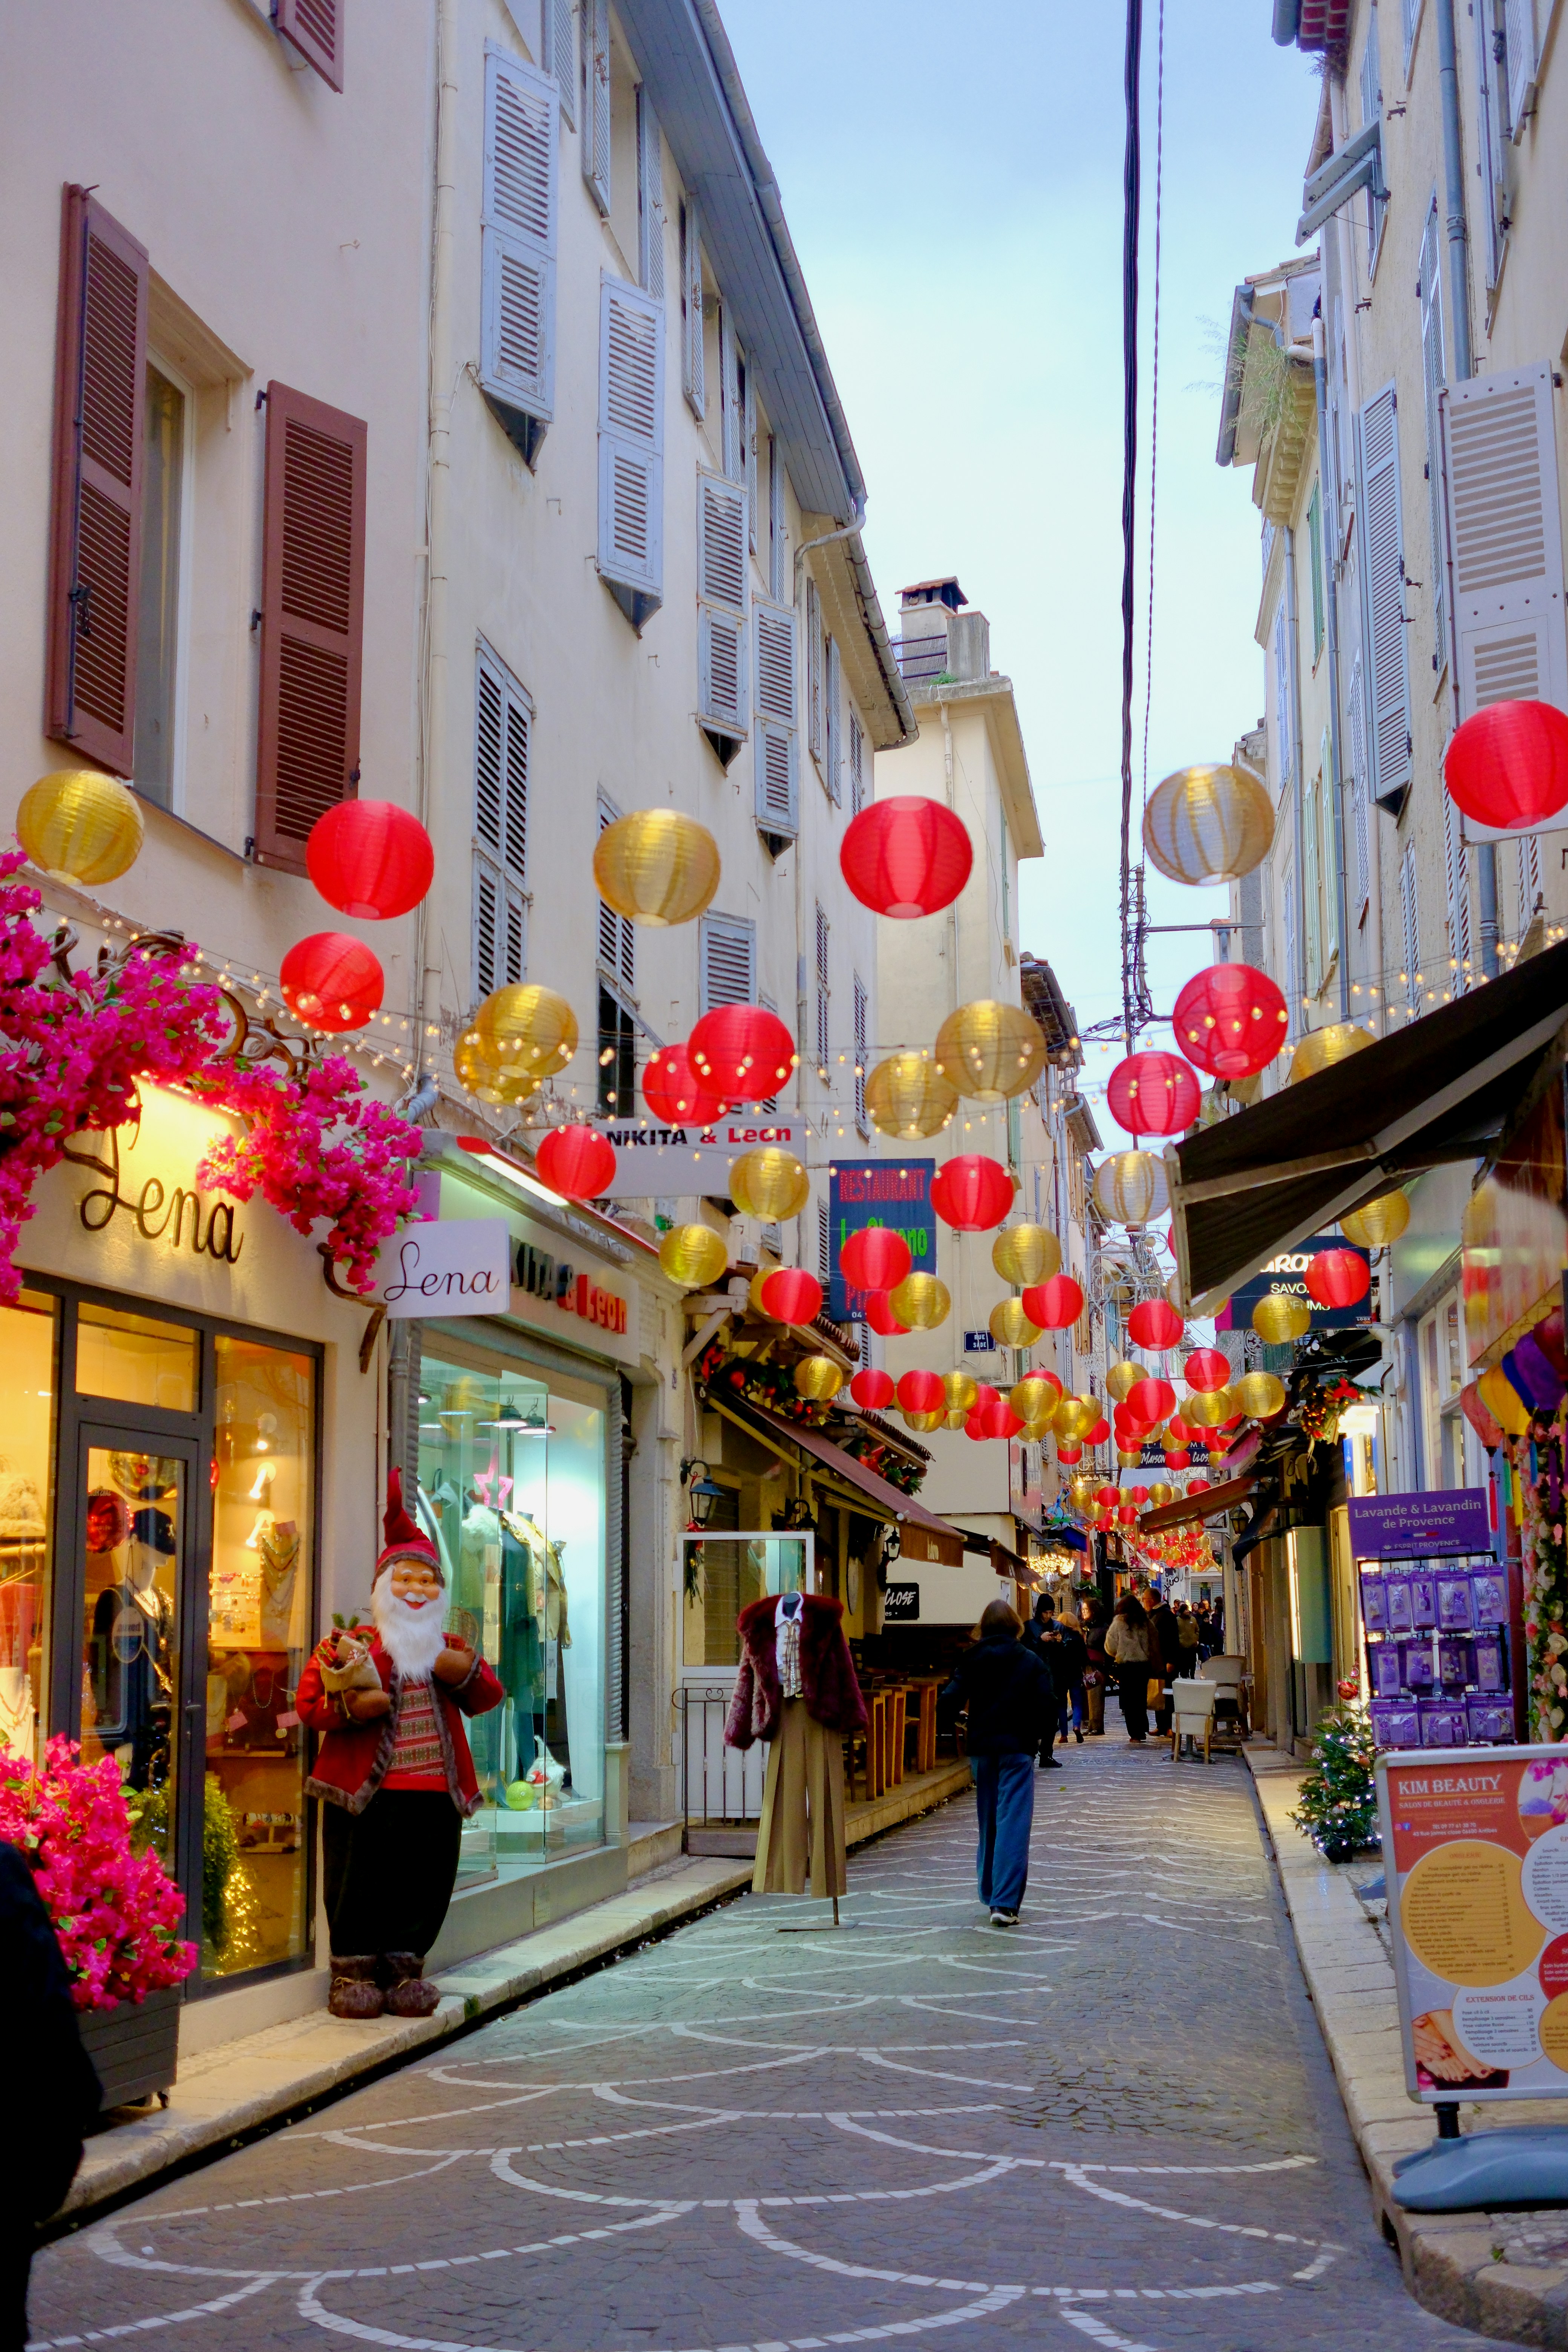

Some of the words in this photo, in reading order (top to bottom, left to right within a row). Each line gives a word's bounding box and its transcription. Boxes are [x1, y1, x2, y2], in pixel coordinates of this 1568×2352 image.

[606, 1129, 688, 1147] NIKITA
[700, 1129, 718, 1144] &
[728, 1128, 791, 1143] Leon
[839, 1168, 926, 1202] RESTAURANT
[384, 1241, 500, 1301] Lena
[576, 1273, 628, 1335] Leon
[1354, 1504, 1408, 1518] Lavande
[1411, 1504, 1420, 1514] &
[1423, 1499, 1482, 1514] Lavandin
[1383, 1519, 1397, 1529] de
[1399, 1516, 1456, 1528] Provence
[1418, 1539, 1461, 1548] PROVENCE
[1398, 1780, 1429, 1795] KIM
[1432, 1773, 1502, 1793] BEAUTY
